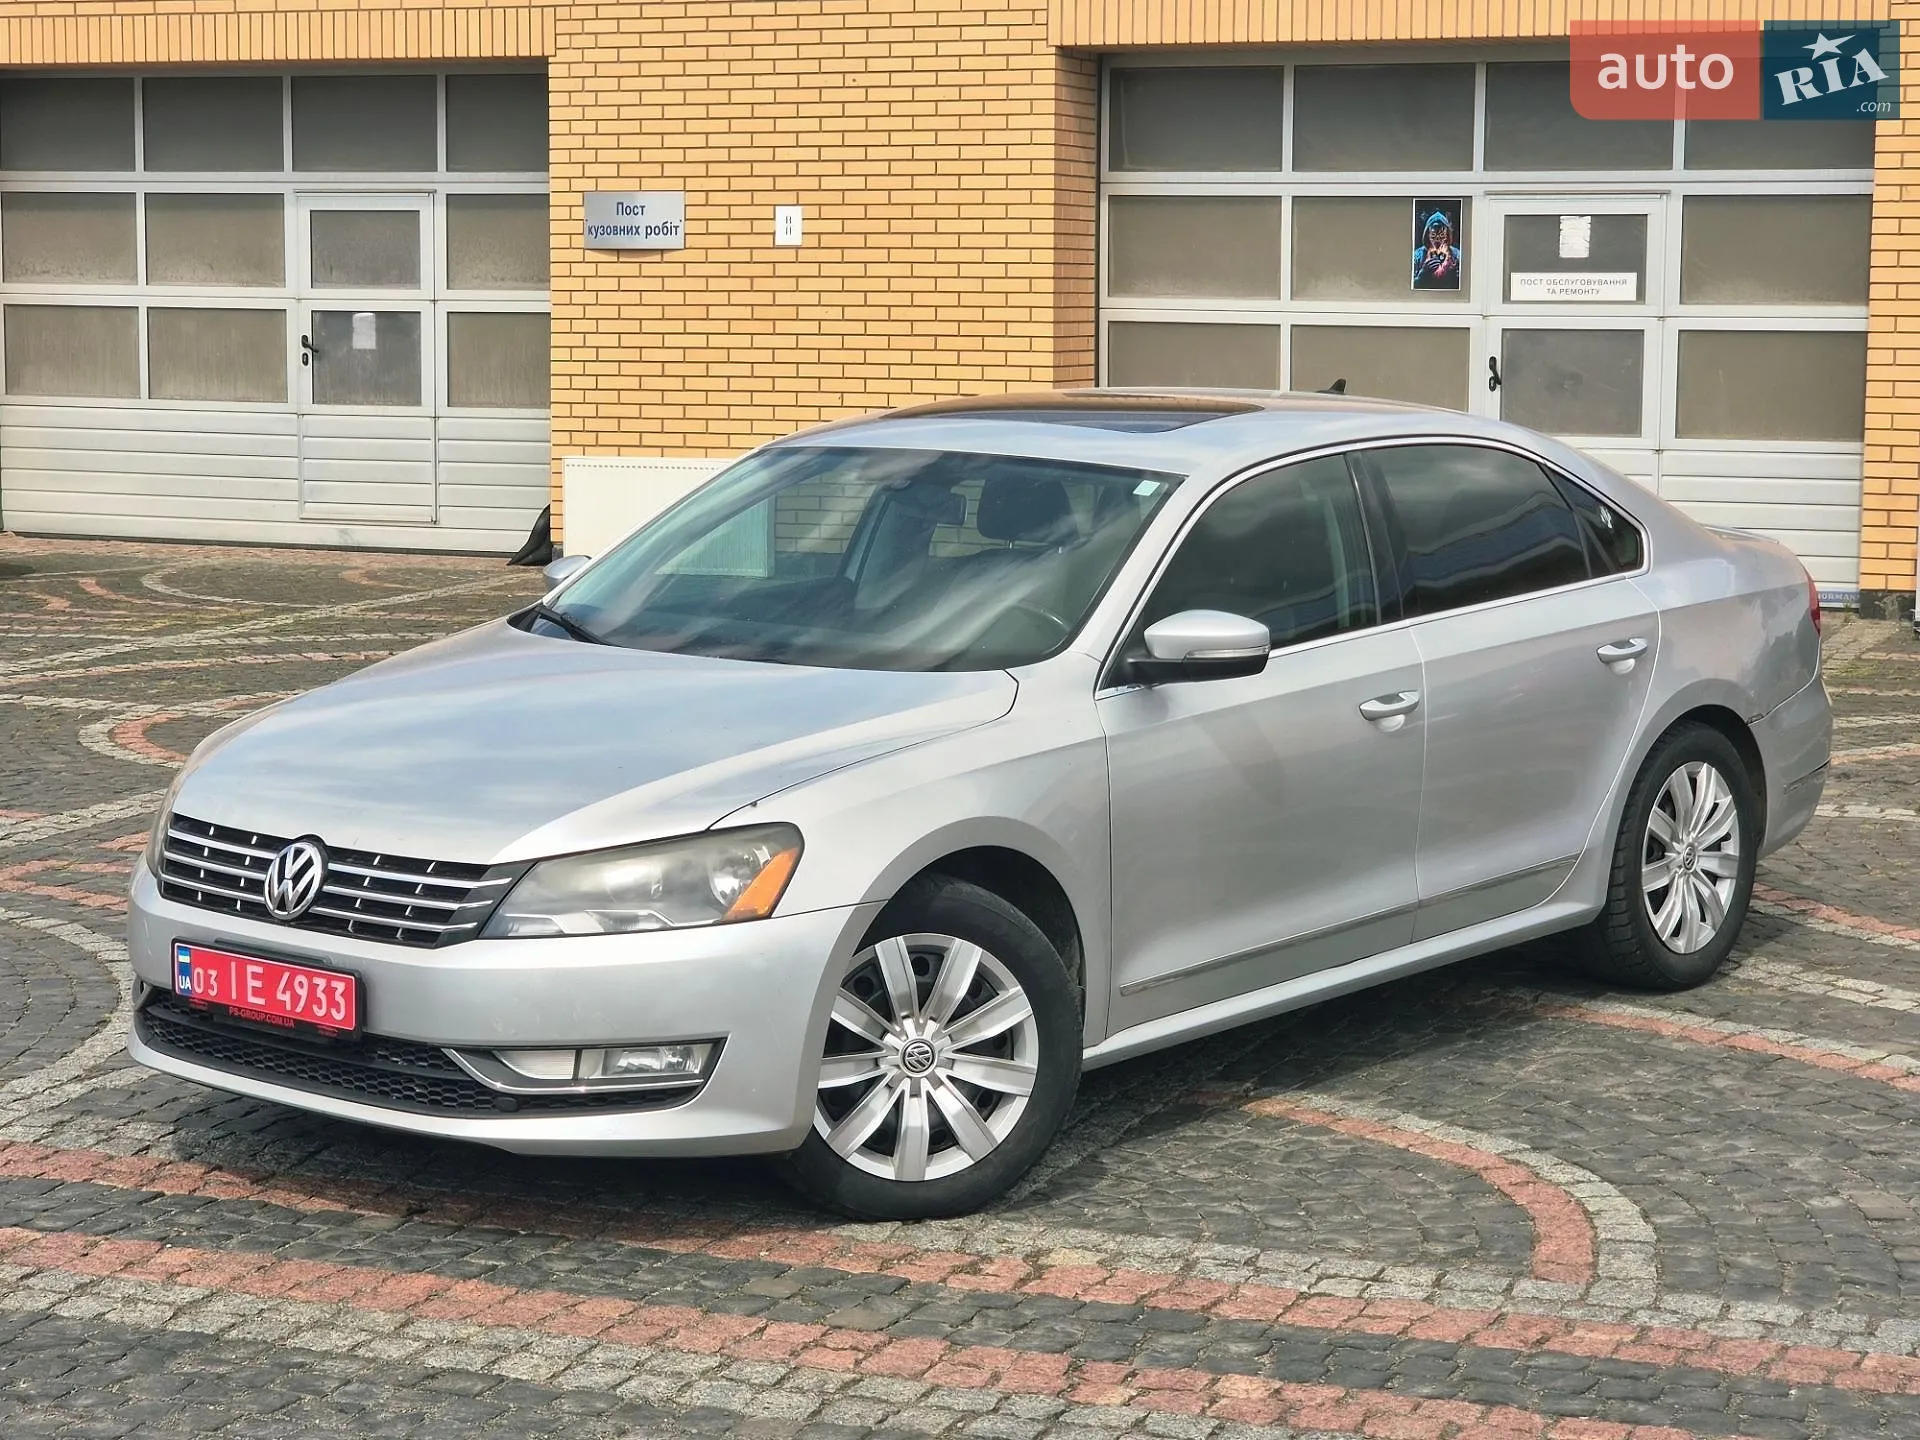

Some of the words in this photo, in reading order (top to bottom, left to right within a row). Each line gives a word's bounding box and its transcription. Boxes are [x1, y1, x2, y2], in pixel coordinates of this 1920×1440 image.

[616, 202, 646, 216] Пост
[588, 224, 640, 239] кузовних
[645, 221, 680, 240] робіт
[1519, 278, 1543, 287] ПОСТ
[1545, 278, 1628, 287] ОБСЛУГОВУВАННЯ
[1546, 288, 1557, 296] ТА
[1559, 288, 1601, 296] РЕМОНТУ
[179, 975, 192, 991] UA
[193, 967, 218, 997] 03
[276, 971, 346, 1021] 4933
